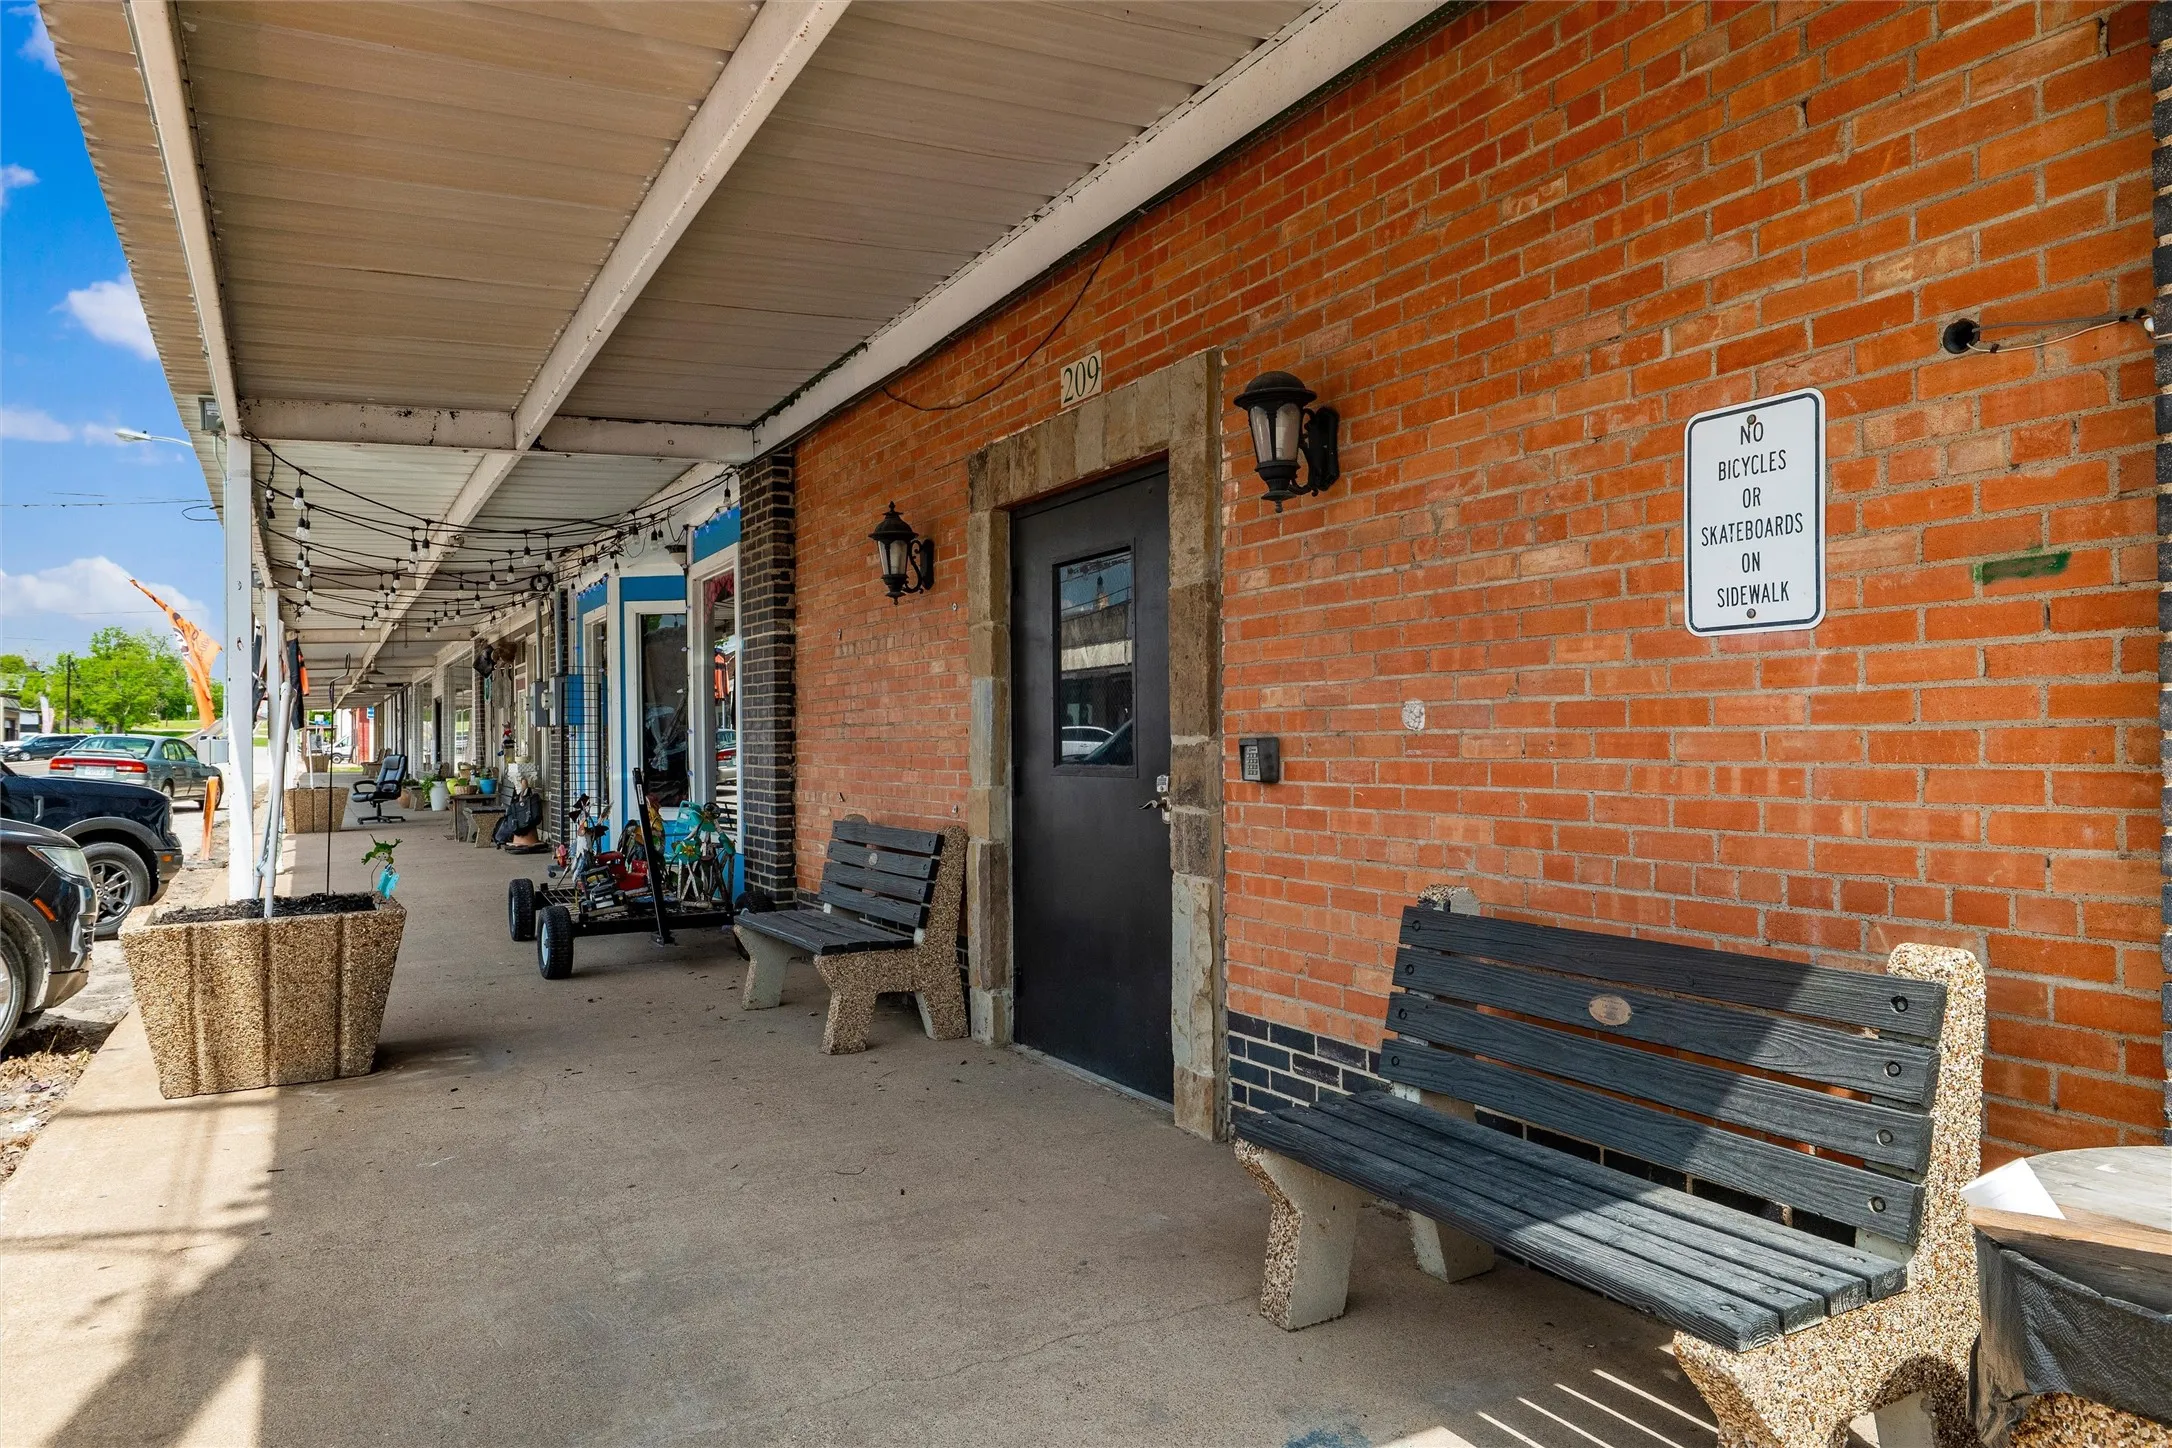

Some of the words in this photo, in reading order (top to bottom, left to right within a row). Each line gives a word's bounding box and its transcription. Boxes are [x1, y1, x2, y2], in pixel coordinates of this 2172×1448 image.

[1063, 355, 1099, 404] 209
[1740, 421, 1764, 446] NO
[1718, 449, 1787, 481] BICYCLES
[1742, 486, 1761, 509] OR
[1701, 512, 1804, 547] SKATEBOARDS
[1741, 551, 1761, 573] ON
[1717, 580, 1790, 608] SIDEWALK
